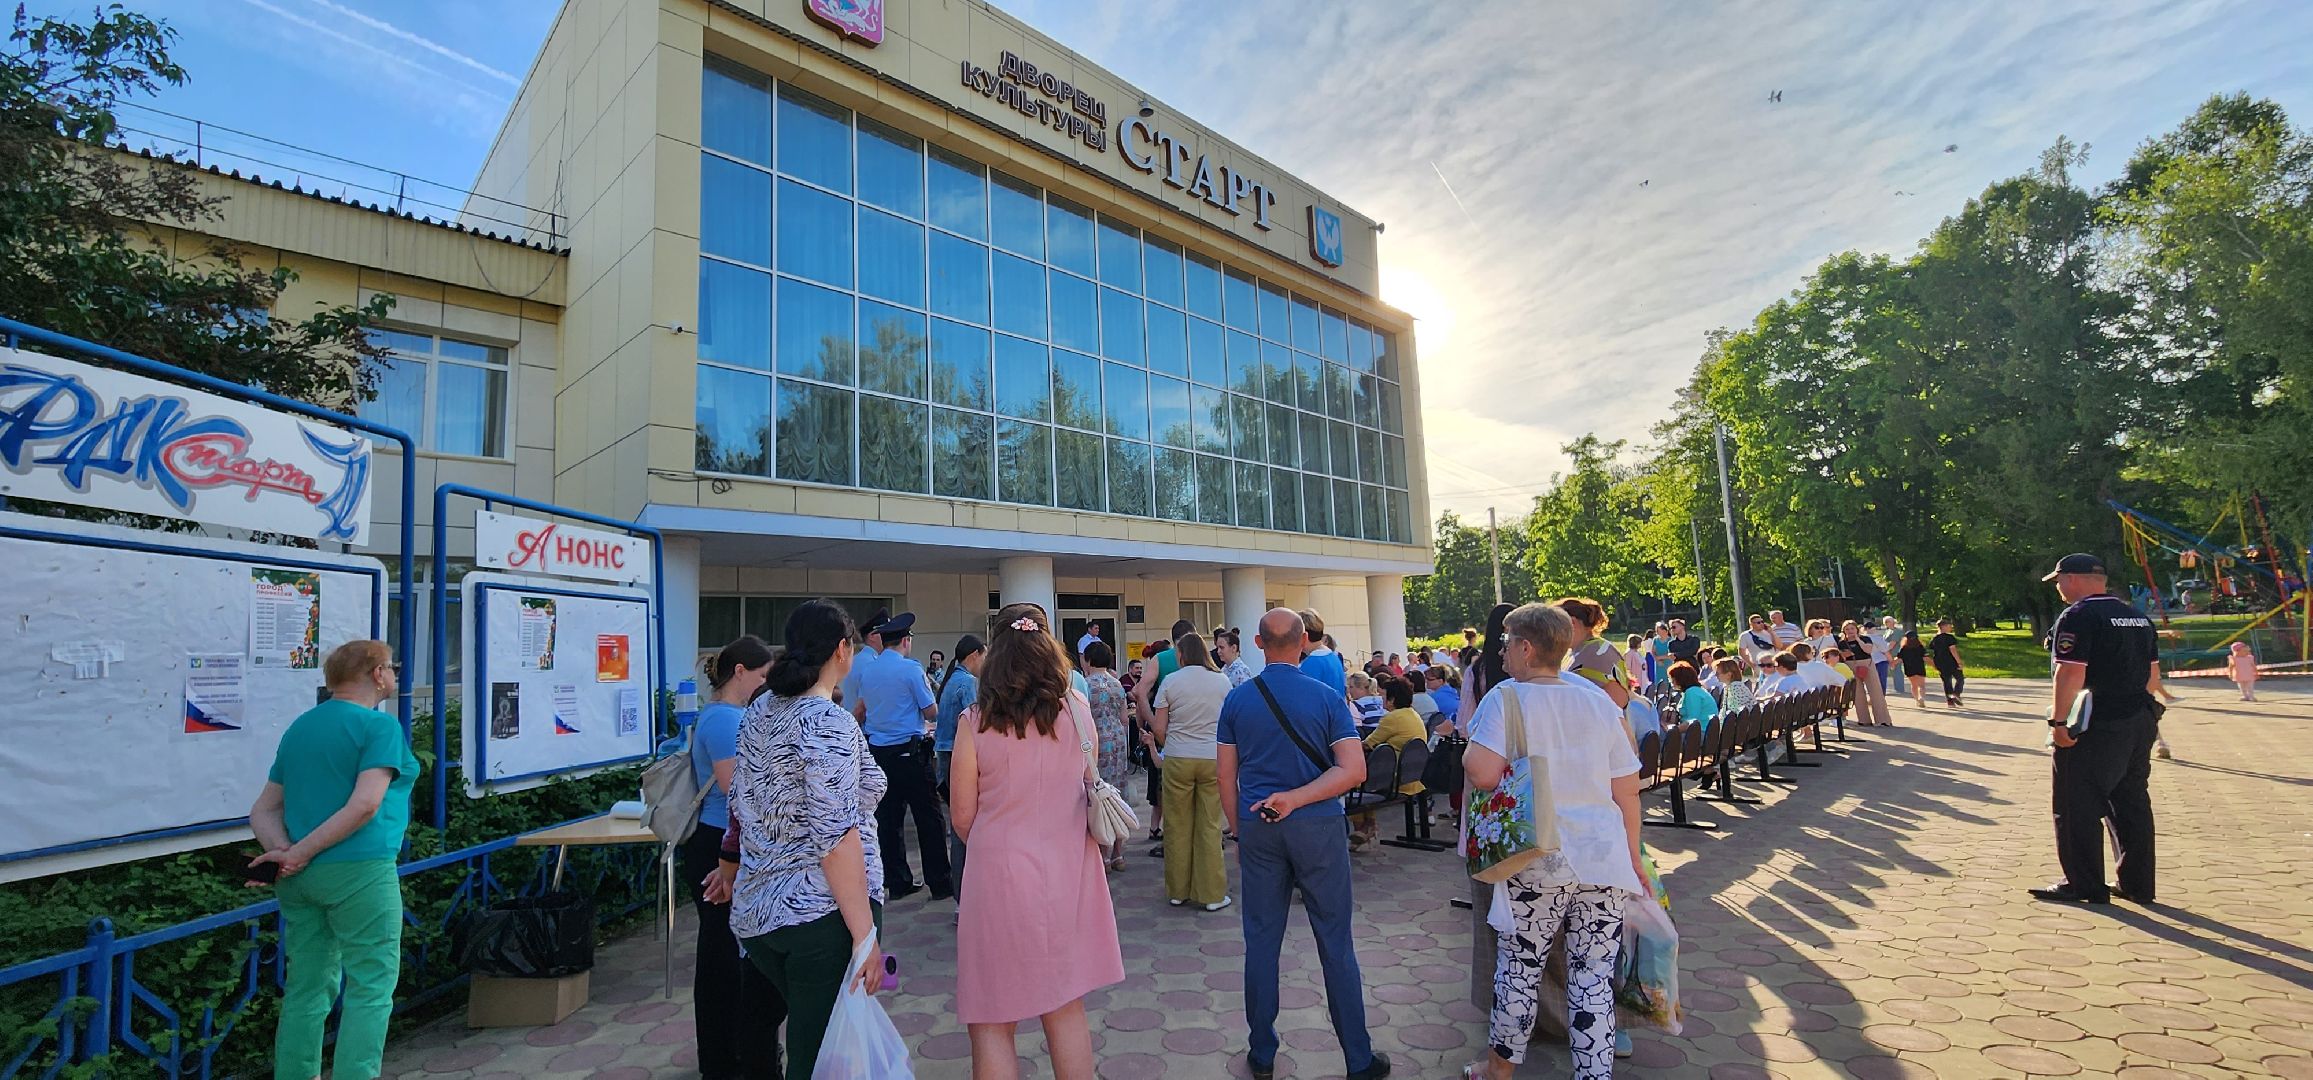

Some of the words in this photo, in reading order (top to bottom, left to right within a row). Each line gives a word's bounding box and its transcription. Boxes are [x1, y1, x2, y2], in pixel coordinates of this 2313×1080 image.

[961, 60, 1107, 153] КУЛЬТУРЫ
[1000, 49, 1107, 128] ДВОРЕЦ
[1116, 115, 1277, 232] СТАРТ
[0, 364, 252, 513] РДК
[256, 583, 283, 592] ГОРОД
